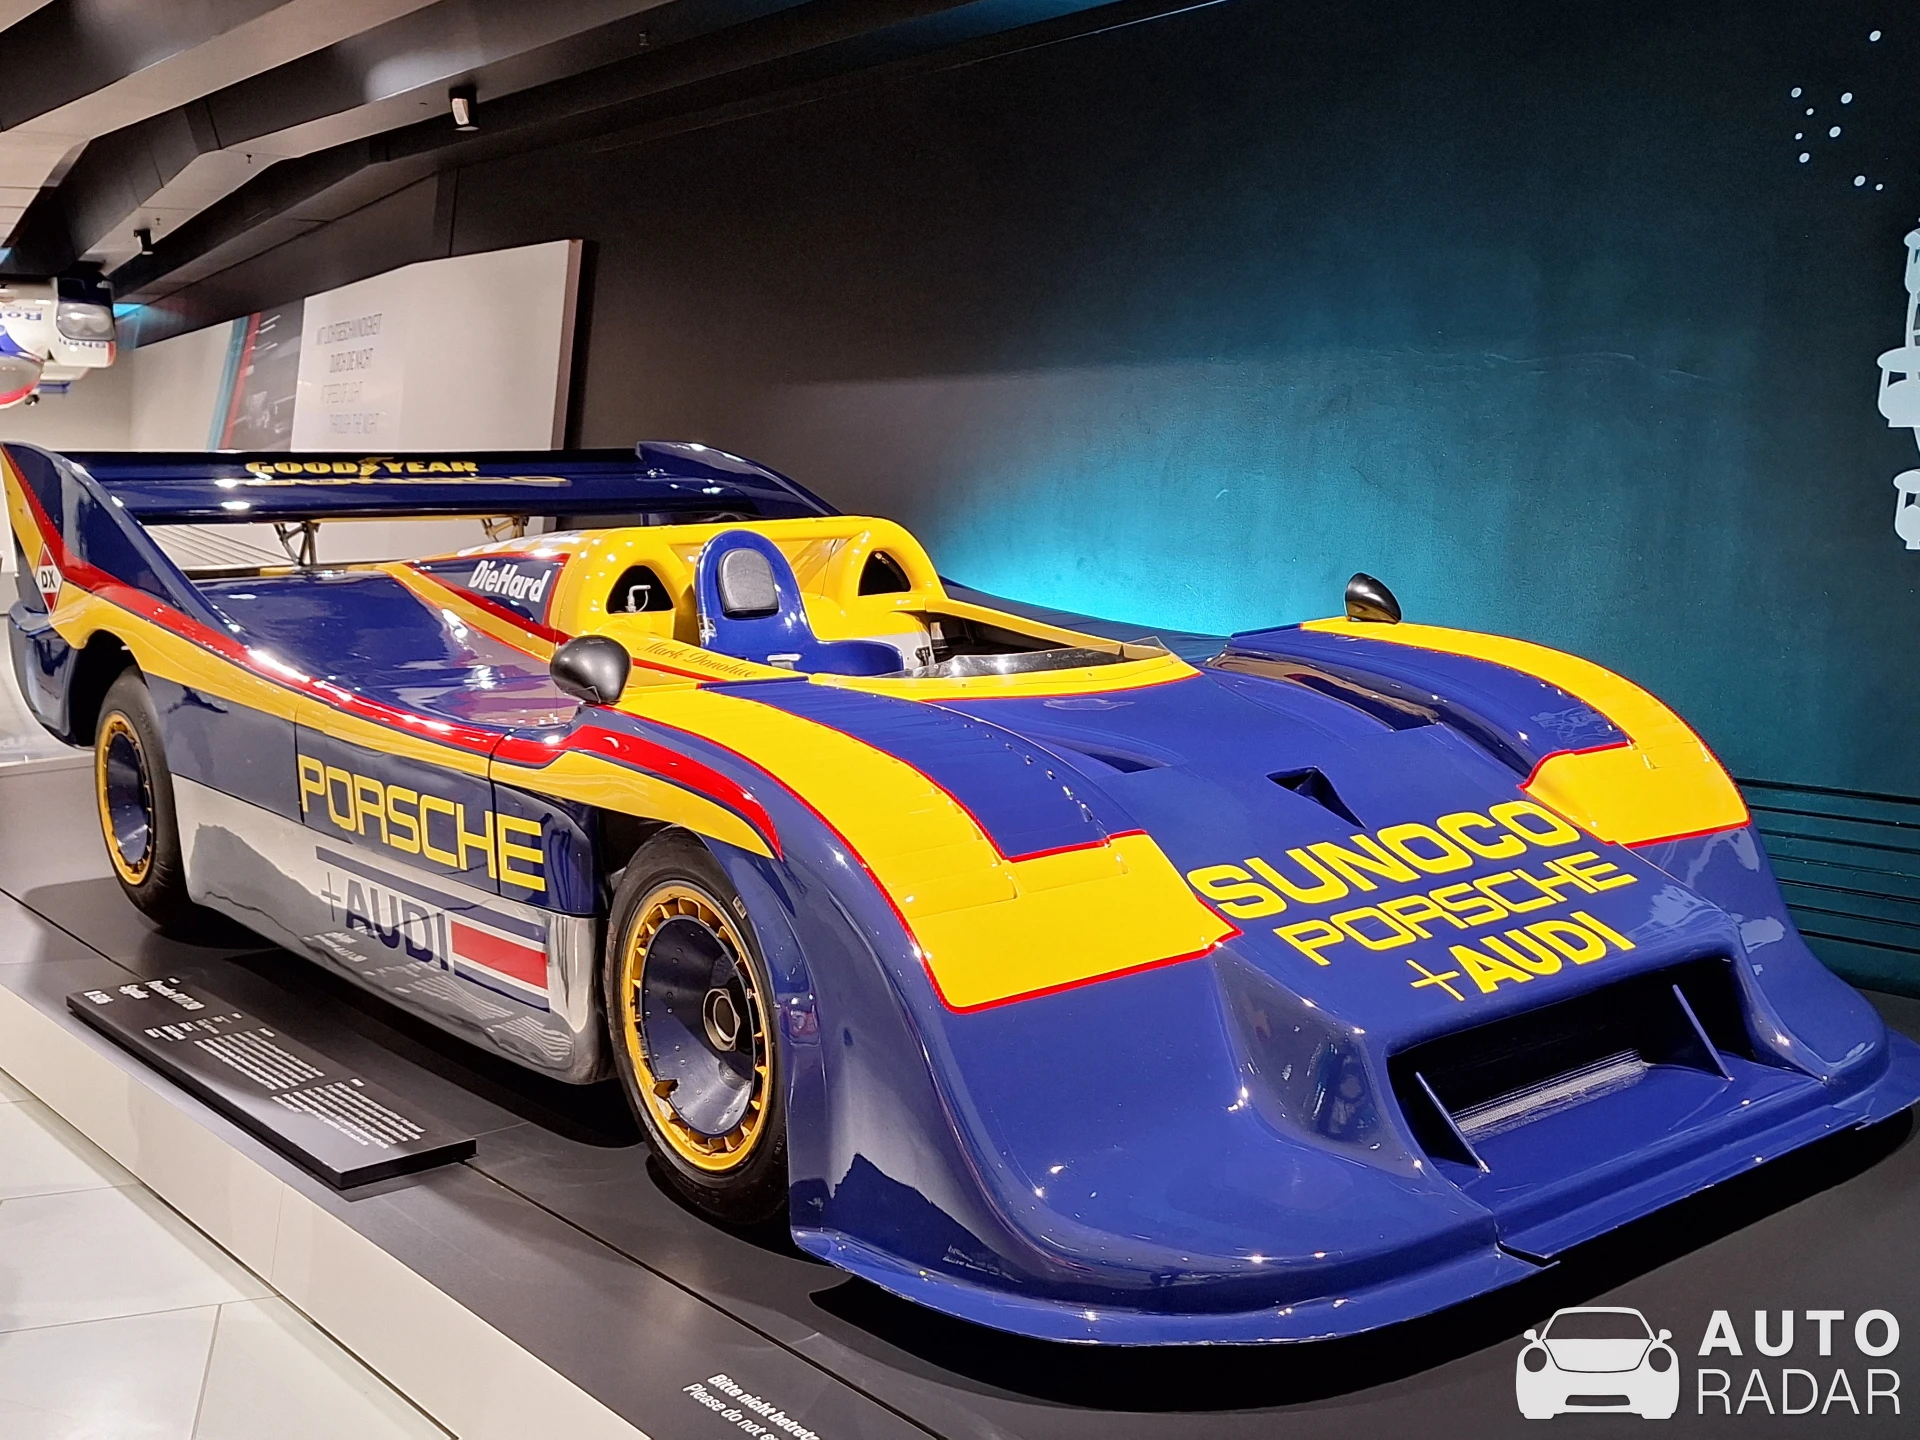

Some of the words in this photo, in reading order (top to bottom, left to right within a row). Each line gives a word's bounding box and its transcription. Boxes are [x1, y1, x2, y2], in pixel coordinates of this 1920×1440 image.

[41, 569, 57, 588] DX
[468, 559, 551, 603] DieHard
[637, 641, 690, 660] Mark
[683, 652, 757, 678] Donohue
[298, 754, 546, 892] PORSCHE
[1187, 800, 1581, 919] SUNOCO
[1273, 851, 1638, 966] PORSCHE
[683, 1383, 727, 1412] Please
[720, 1408, 743, 1423] do
[736, 1418, 767, 1437] not
[707, 1373, 743, 1398] Bitte
[736, 1393, 777, 1418] nicht
